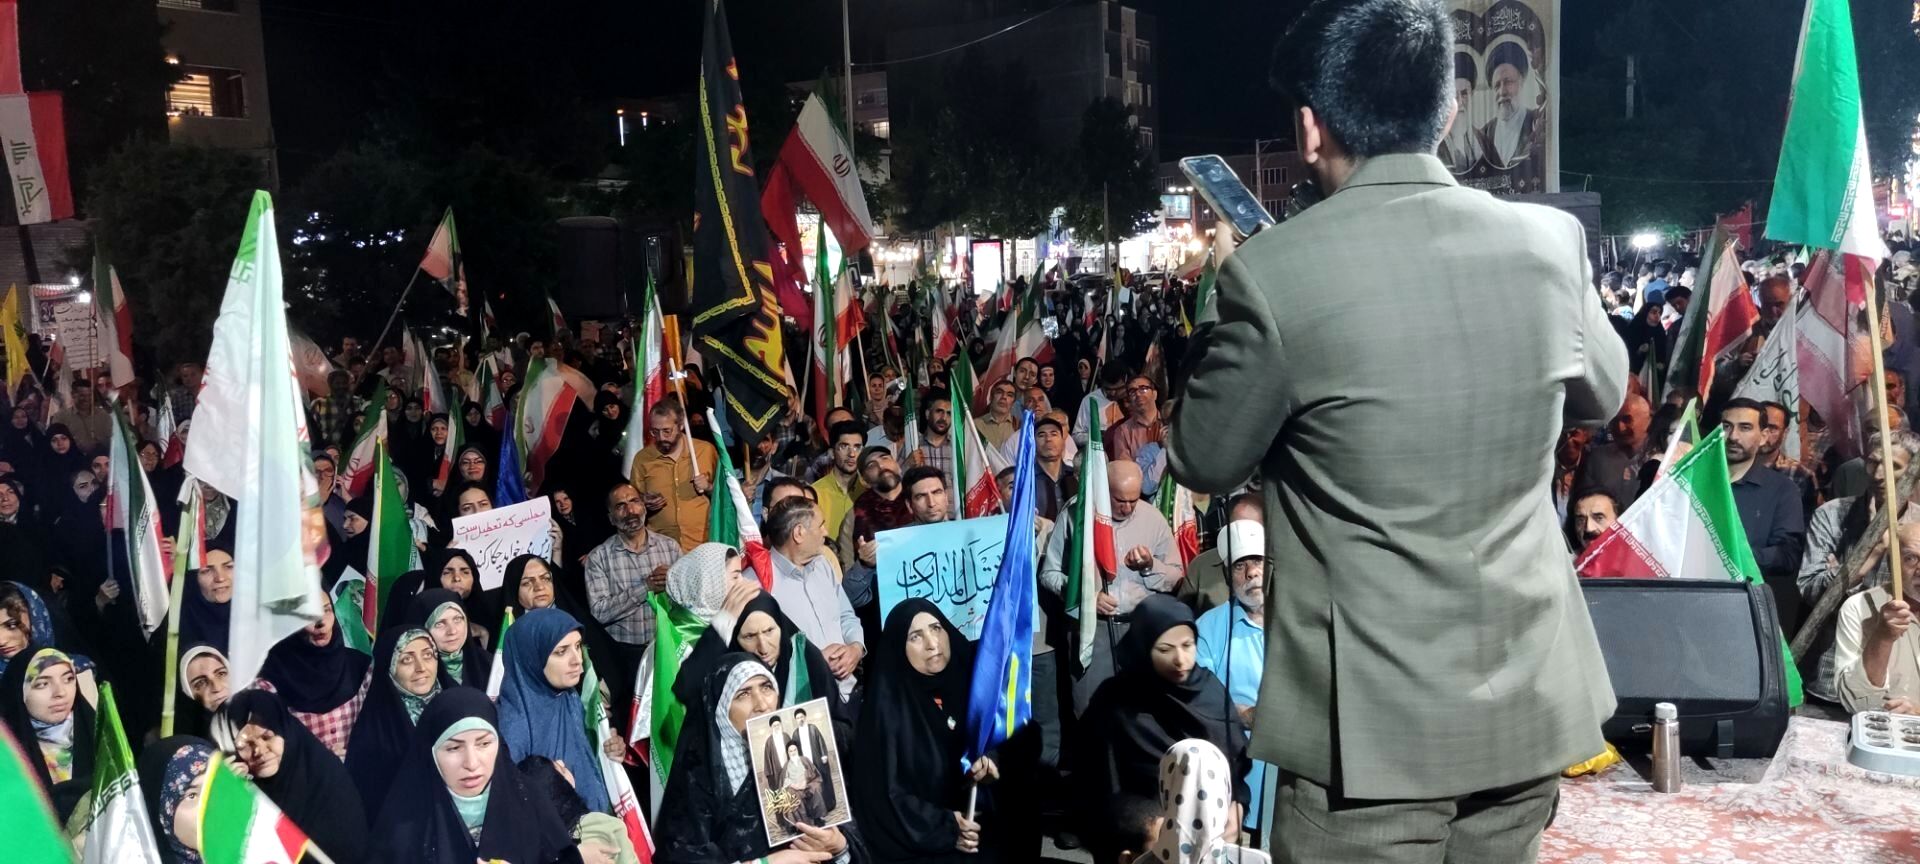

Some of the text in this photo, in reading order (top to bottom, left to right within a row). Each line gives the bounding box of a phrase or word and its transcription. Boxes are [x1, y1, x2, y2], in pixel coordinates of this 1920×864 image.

[503, 514, 517, 528] که
[514, 507, 546, 528] مجلسی
[896, 548, 968, 605] المذاکات
